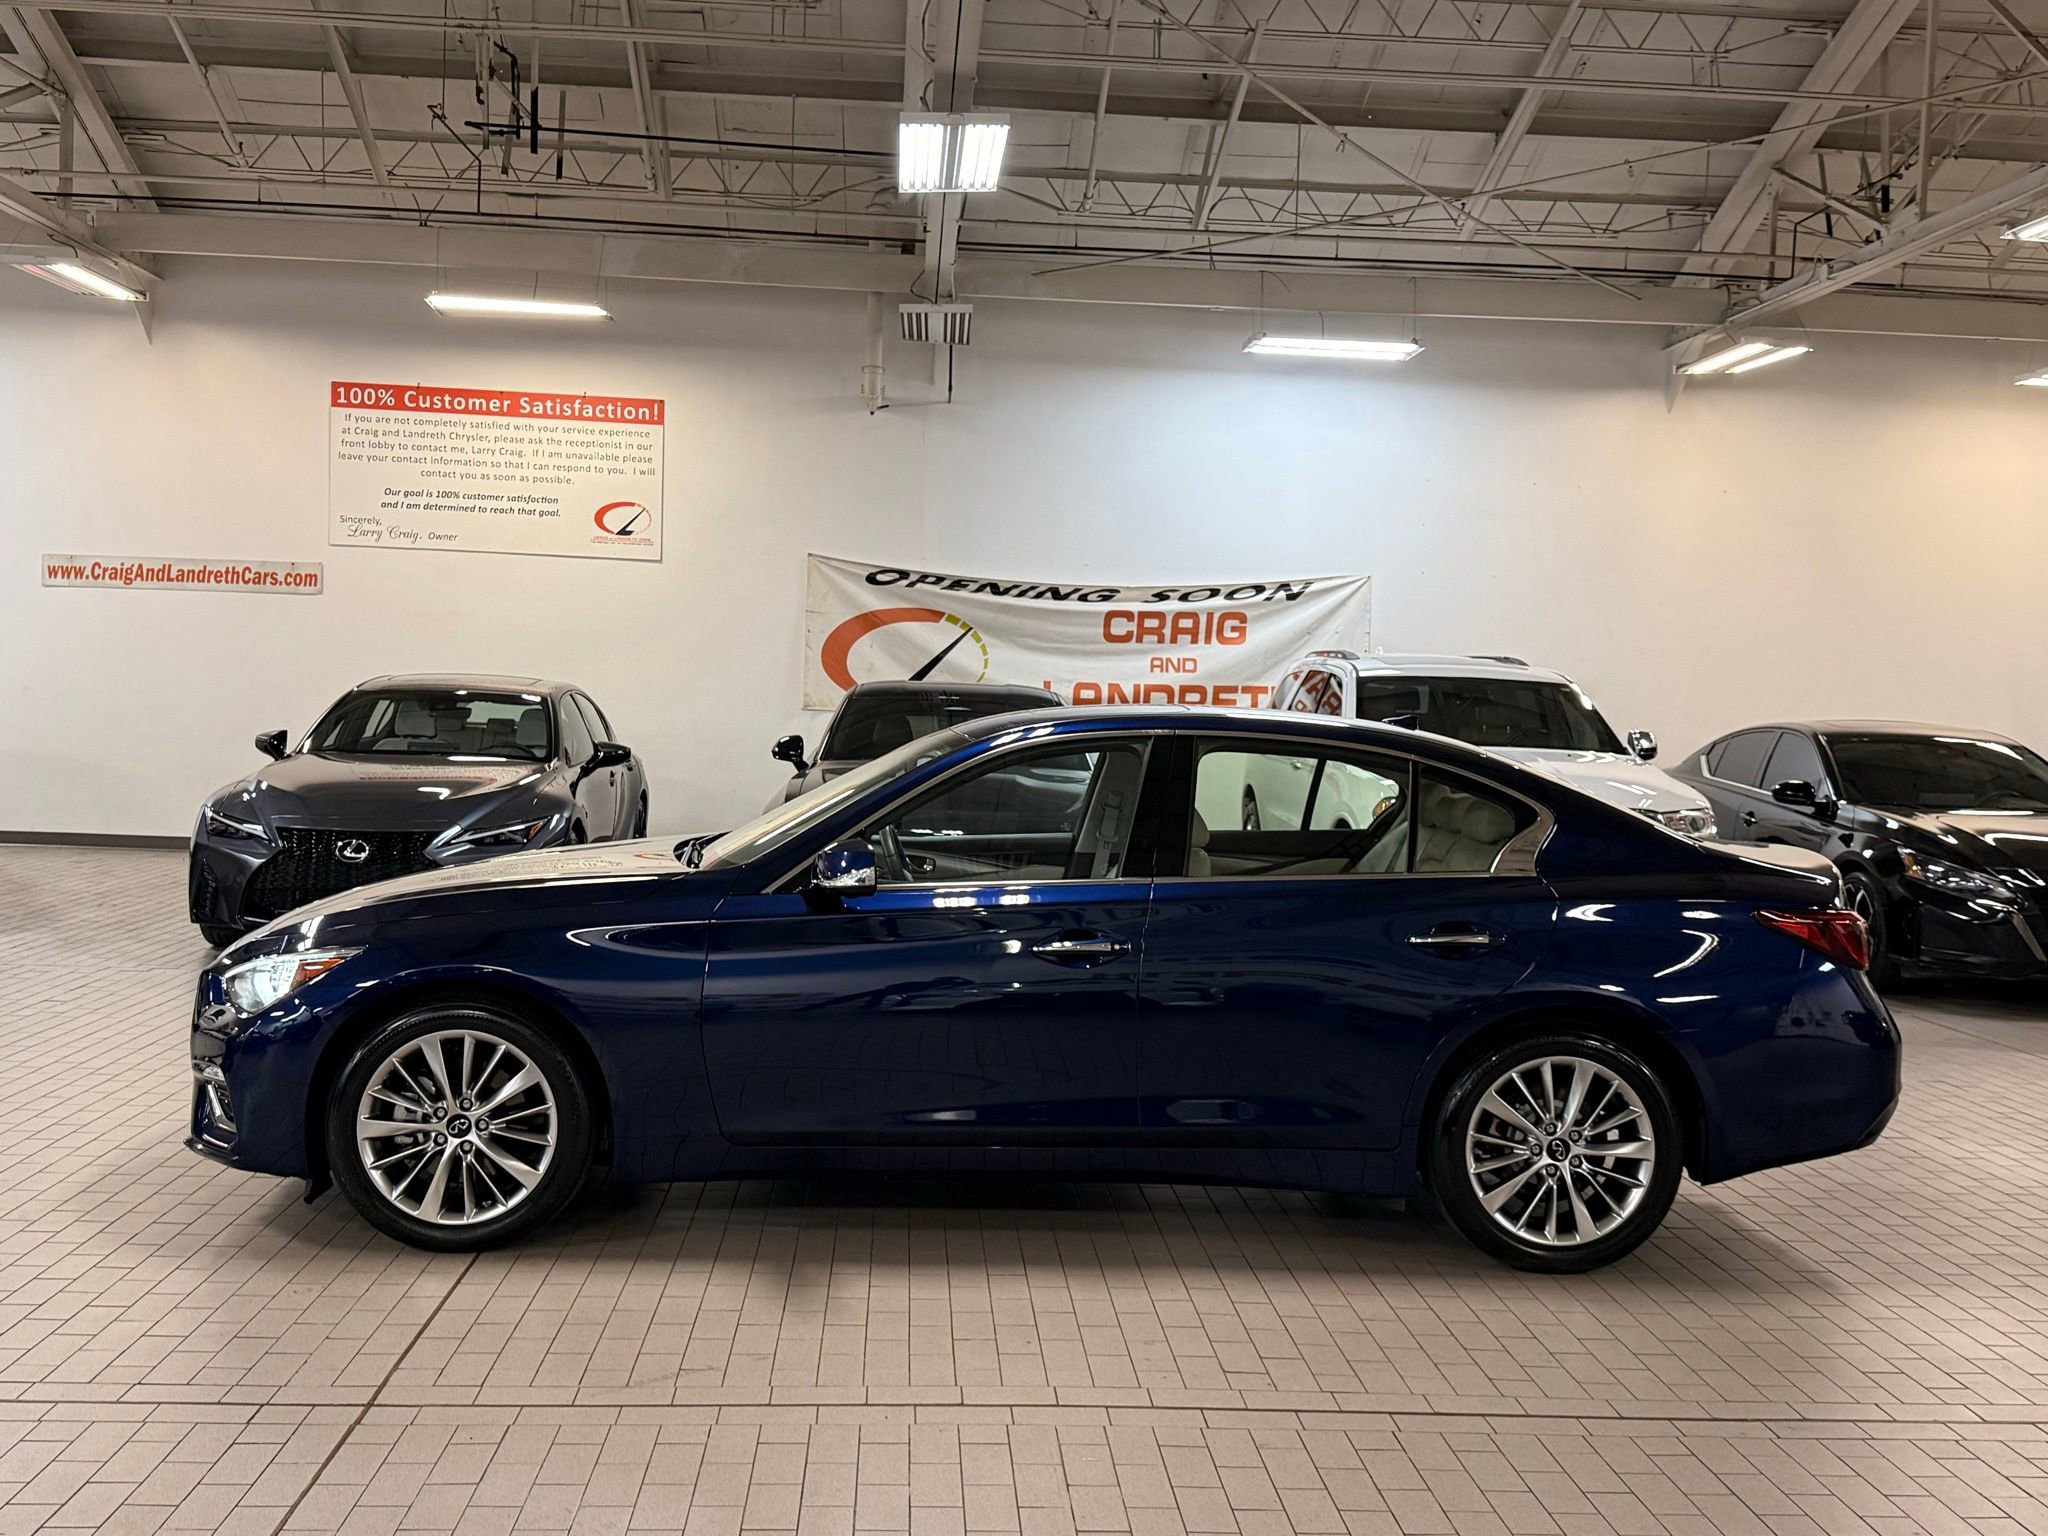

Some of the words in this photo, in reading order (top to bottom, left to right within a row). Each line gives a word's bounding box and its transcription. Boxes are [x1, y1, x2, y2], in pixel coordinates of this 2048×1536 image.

[336, 386, 395, 406] 100%
[403, 390, 511, 413] Customer
[519, 396, 658, 420] Satisfaction!
[344, 412, 351, 421] If
[354, 415, 372, 424] you
[375, 416, 391, 424] are
[394, 417, 410, 425] not
[413, 418, 466, 429] completely
[469, 420, 510, 430] satisfied
[513, 423, 534, 431] with
[562, 427, 595, 435] service
[598, 428, 650, 438] experience
[354, 426, 378, 438] Craig
[381, 428, 399, 437] and
[402, 429, 446, 439] Landreth
[448, 431, 490, 443] Chrysler,
[494, 434, 524, 444] please
[527, 436, 543, 444] ask
[546, 437, 562, 446] the
[565, 440, 621, 449] receptionist
[625, 441, 633, 449] in
[341, 438, 365, 448] front
[368, 440, 395, 451] lobby
[398, 442, 408, 450] to
[411, 444, 447, 452] contact
[450, 446, 468, 454] me,
[471, 445, 496, 456] Larry
[498, 447, 526, 458] Craig.
[532, 449, 538, 457] If
[565, 452, 619, 462] unavailable
[622, 454, 652, 463] please
[338, 451, 363, 461] leave
[366, 454, 388, 462] your
[391, 455, 427, 464] contact
[430, 456, 487, 467] information
[504, 460, 523, 469] that
[552, 464, 590, 473] respond
[594, 465, 604, 473] to
[606, 467, 626, 475] you.
[639, 467, 655, 476] will
[420, 470, 456, 478] contact
[459, 472, 476, 480] you
[493, 473, 516, 481] soon
[532, 475, 574, 484] possible.
[384, 487, 401, 496] Our
[403, 488, 424, 498] goal
[425, 489, 433, 498] is
[435, 490, 460, 499] 100%
[462, 493, 505, 501] customer
[506, 494, 558, 504] satisfaction
[339, 514, 381, 526] Sincerely,
[380, 500, 399, 509] and
[405, 502, 421, 510] am
[422, 501, 476, 512] determined
[478, 505, 487, 513] to
[489, 506, 515, 514] reach
[517, 506, 536, 516] that
[538, 508, 560, 518] goal.
[346, 523, 383, 542] Larry
[427, 531, 458, 541] Owner
[47, 561, 319, 587] www.CraigAndLandrethCars.com
[865, 569, 1121, 602] OPENING
[1141, 582, 1315, 603] SOON
[1102, 610, 1248, 645] CRAIG
[1150, 657, 1197, 673] AND
[1043, 680, 1276, 708] ANDRET
